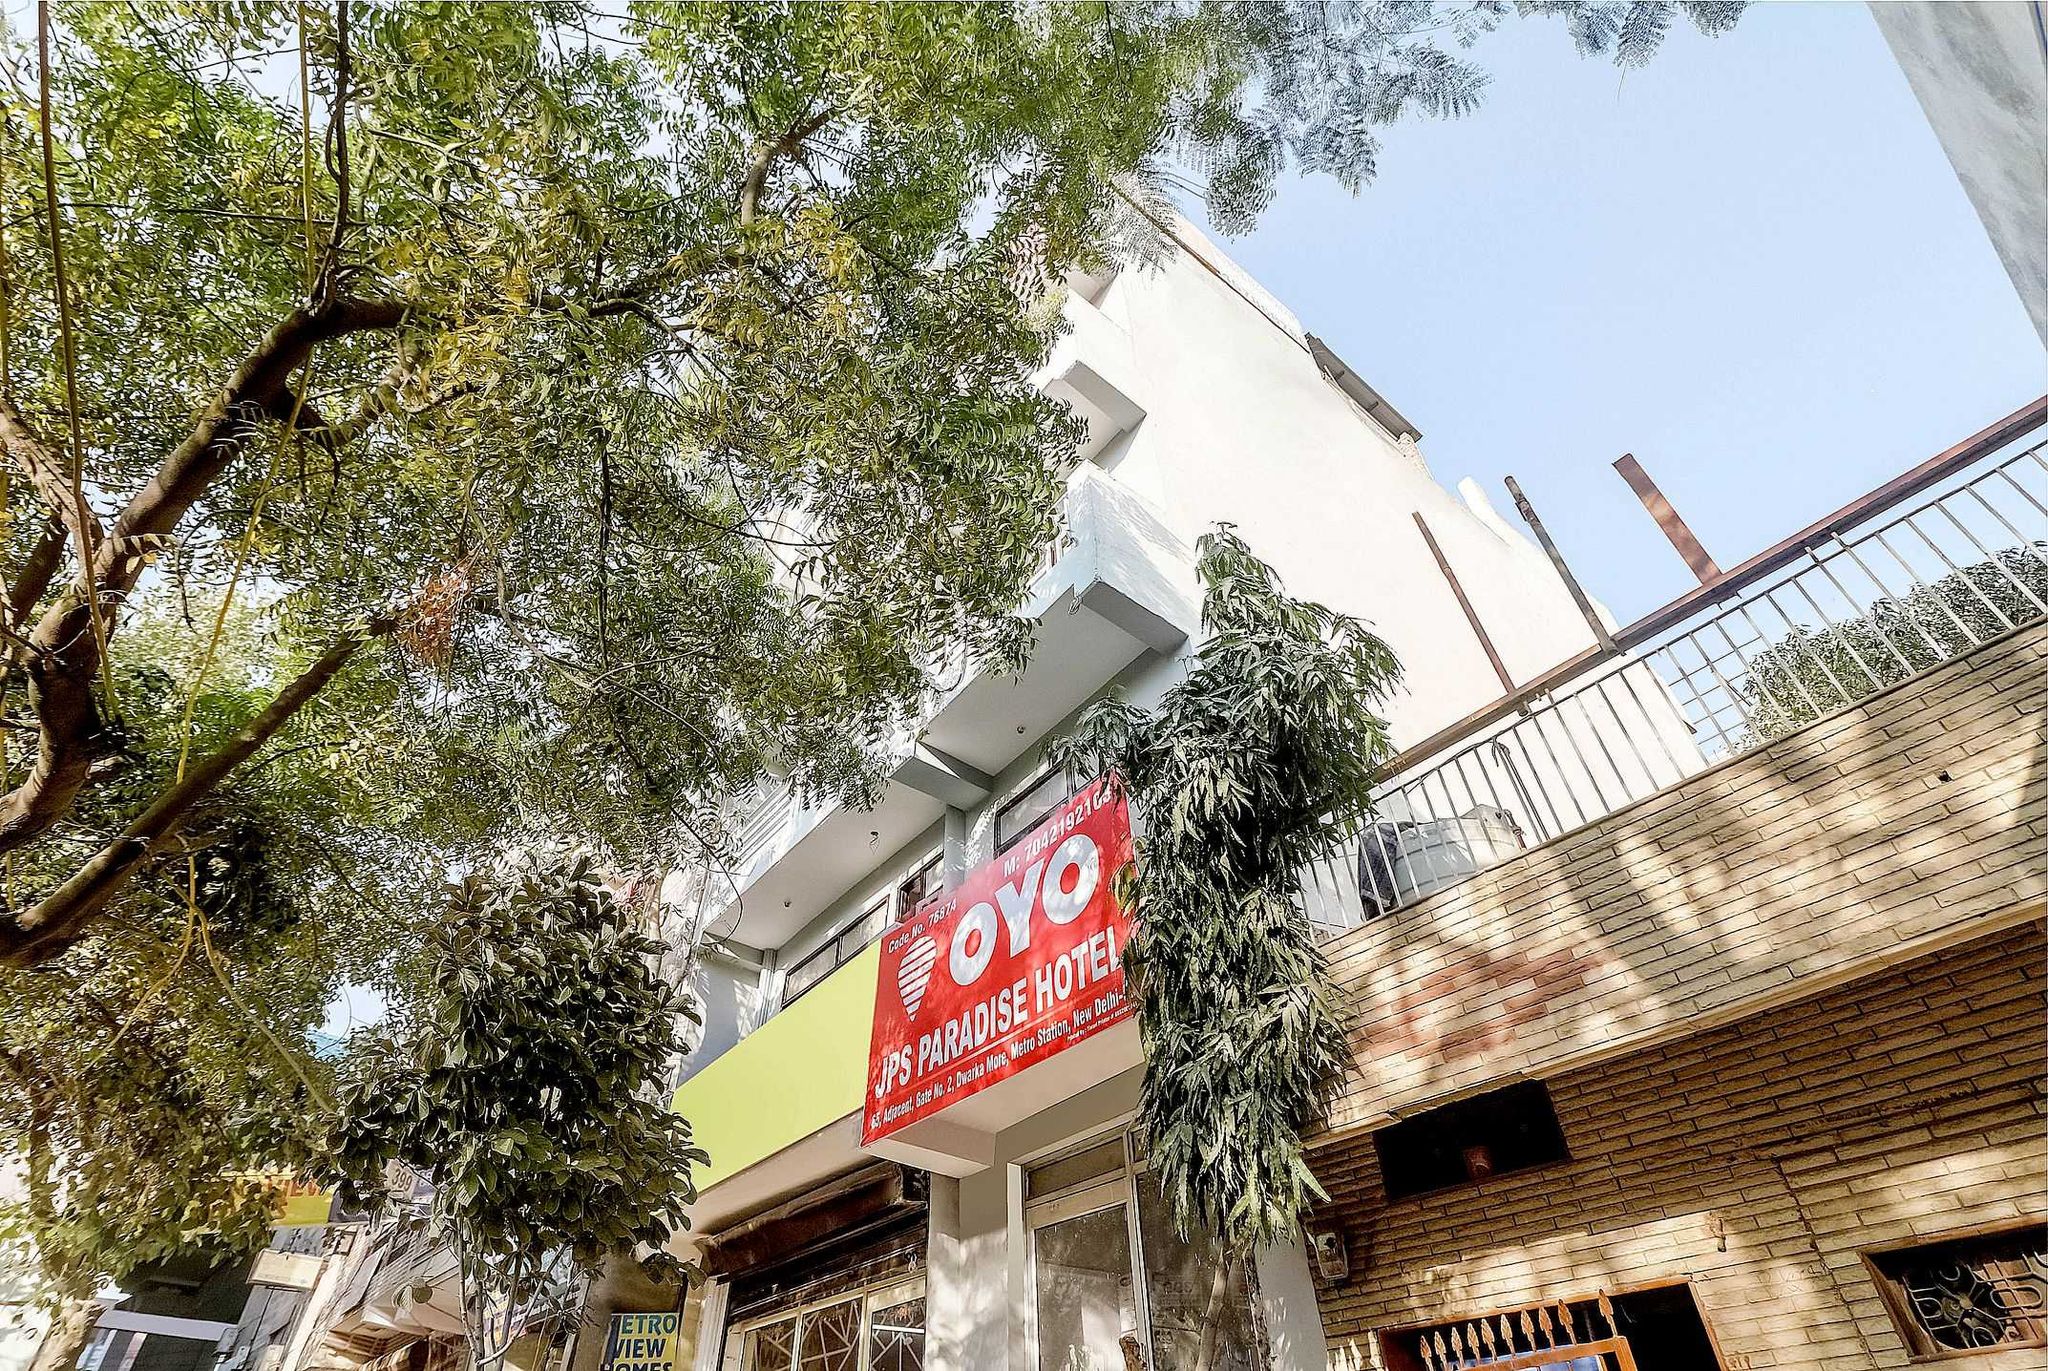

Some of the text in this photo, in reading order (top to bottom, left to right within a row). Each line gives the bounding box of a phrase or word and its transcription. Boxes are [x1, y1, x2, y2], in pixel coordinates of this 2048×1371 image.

[888, 932, 910, 954] Code
[911, 923, 926, 939] No.
[949, 833, 1099, 987] OYO
[874, 1043, 913, 1099] JPS
[917, 977, 1028, 1077] PARADISE
[1034, 925, 1123, 1014] HOTEL
[915, 1088, 933, 1109] Gate
[933, 1082, 946, 1100] No.
[956, 1062, 985, 1088] Dwarka
[986, 1051, 1009, 1074] More,
[1010, 1036, 1036, 1061] Metro
[1037, 1019, 1072, 1048] Station,
[1073, 1005, 1093, 1029] New
[391, 1168, 412, 1192] 399
[620, 1314, 677, 1335] ETRO
